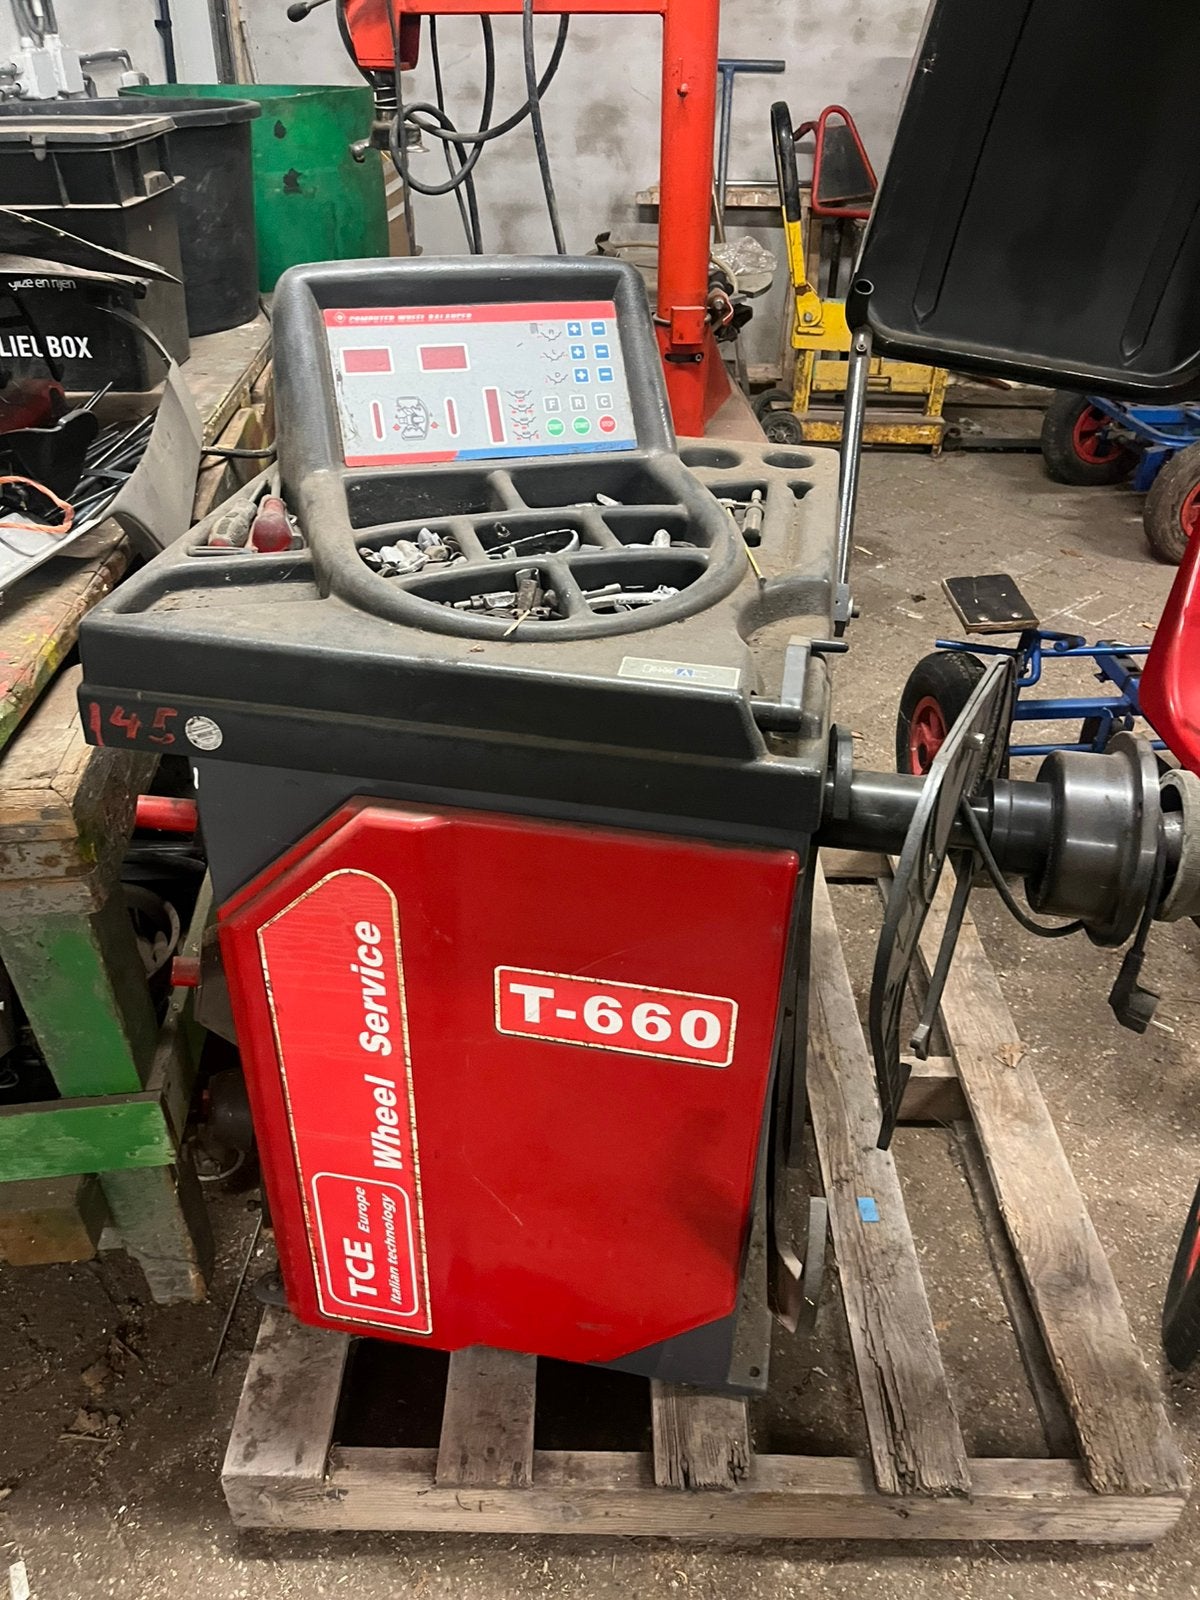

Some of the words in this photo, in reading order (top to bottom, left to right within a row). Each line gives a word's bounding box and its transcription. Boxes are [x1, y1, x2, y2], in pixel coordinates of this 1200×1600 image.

[46, 335, 93, 359] BOX
[549, 400, 556, 409] F
[575, 399, 583, 408] R
[600, 397, 608, 406] C
[351, 920, 393, 1057] Service
[509, 982, 722, 1049] T-660
[363, 1074, 403, 1170] Wheel
[355, 1186, 371, 1234] Europe
[381, 1193, 399, 1265] technology
[342, 1237, 378, 1298] TCE
[387, 1266, 402, 1306] Italian
